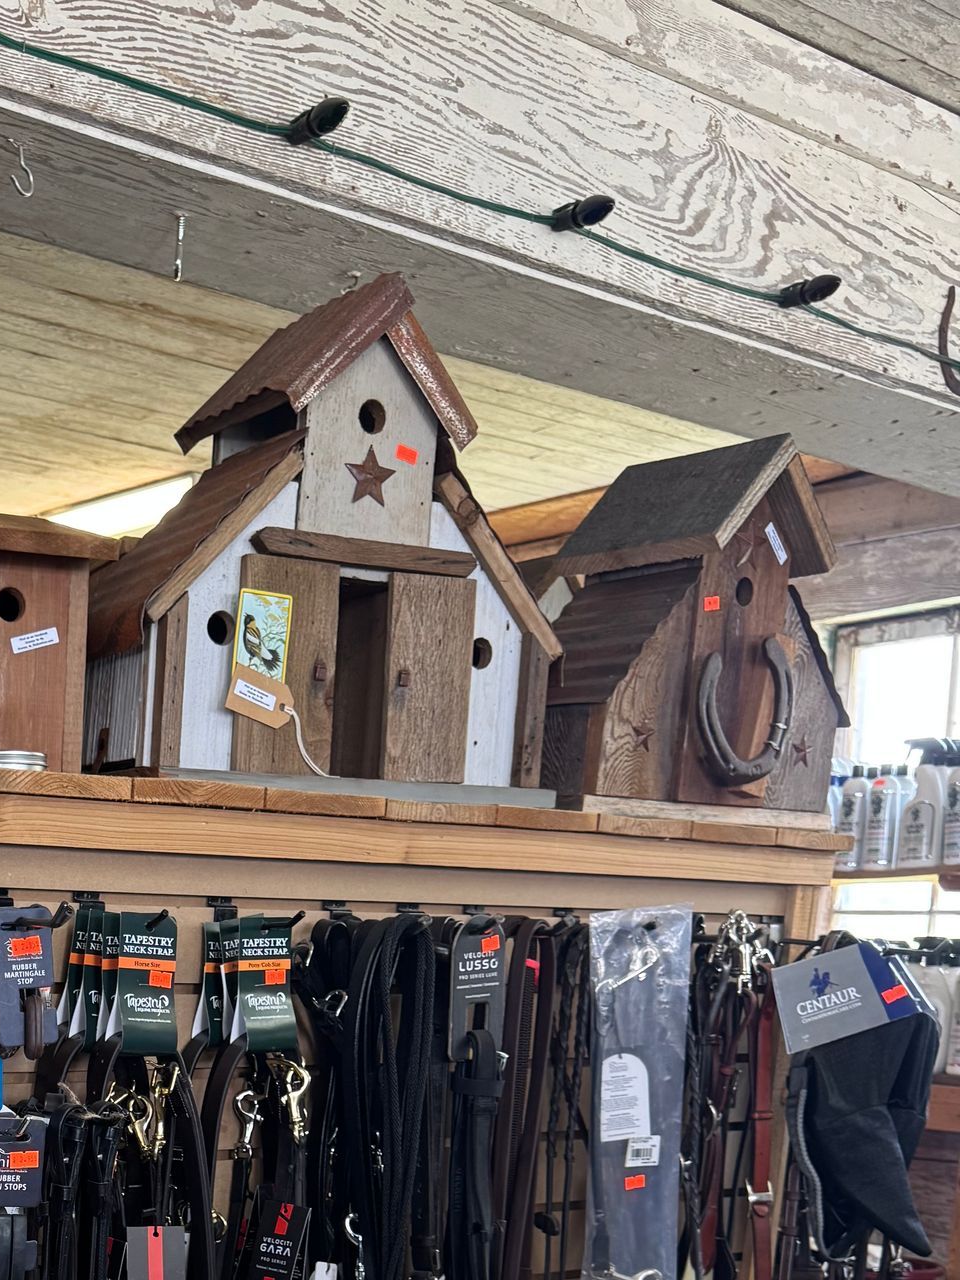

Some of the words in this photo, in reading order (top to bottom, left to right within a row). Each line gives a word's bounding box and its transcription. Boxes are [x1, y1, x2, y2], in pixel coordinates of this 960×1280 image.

[123, 934, 174, 947] TAPESTRY
[241, 937, 288, 949] TAPESTRY
[123, 945, 147, 955] NECK
[12, 963, 37, 971] RUBBER
[459, 959, 498, 972] LUSSO
[5, 970, 45, 978] MARTINGALE
[124, 993, 163, 1016] Tapestry
[796, 986, 861, 1016] CENTAUR
[4, 1183, 27, 1191] STOPS
[263, 1237, 292, 1247] VELOCITI
[260, 1243, 290, 1256] GARA
